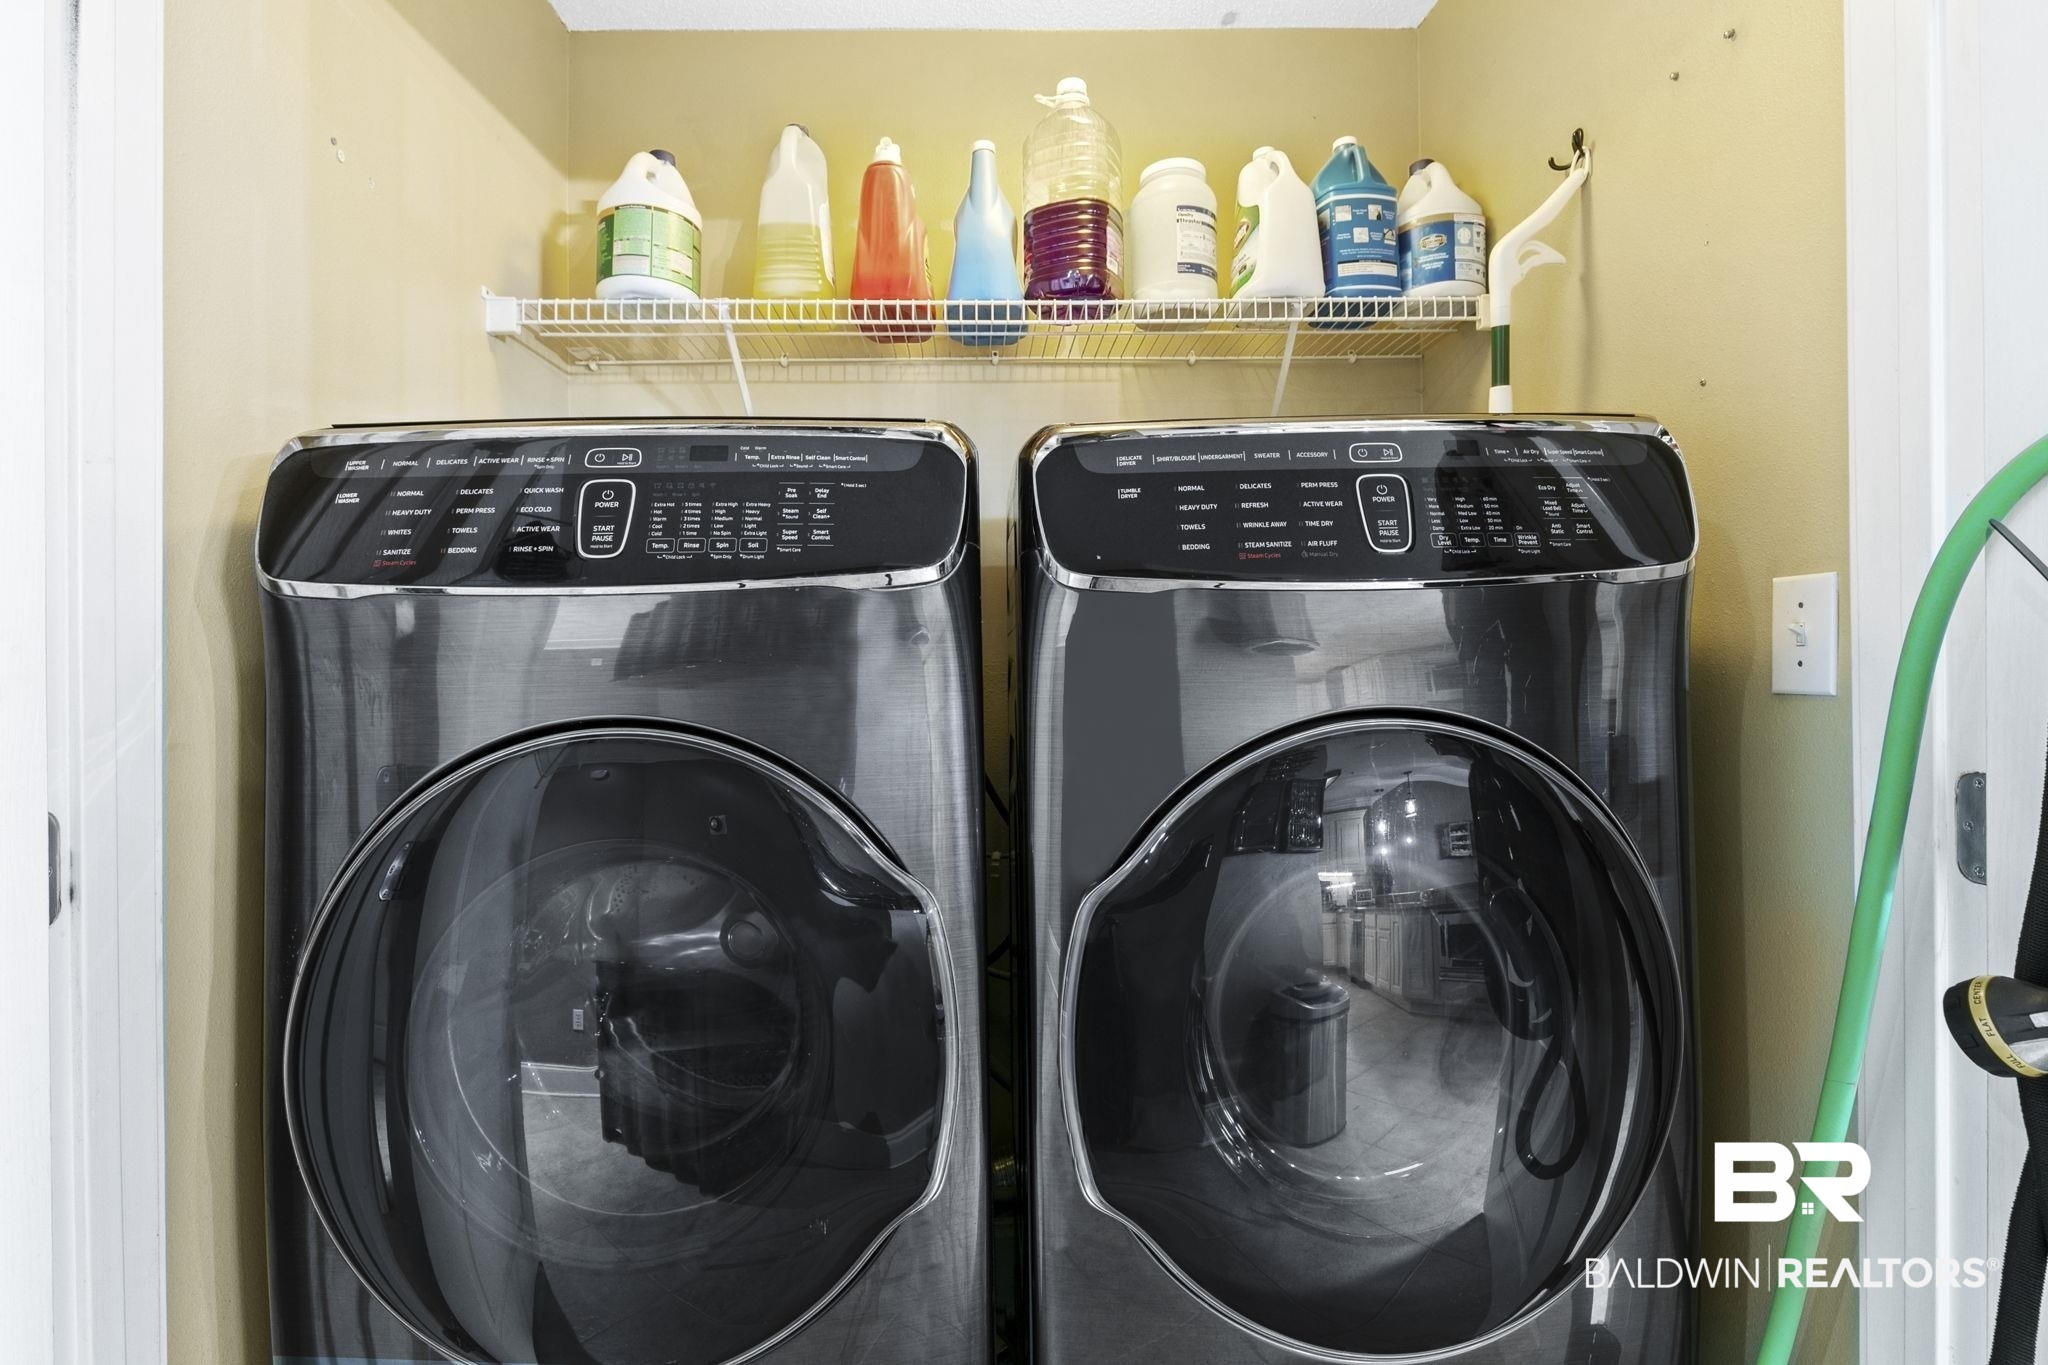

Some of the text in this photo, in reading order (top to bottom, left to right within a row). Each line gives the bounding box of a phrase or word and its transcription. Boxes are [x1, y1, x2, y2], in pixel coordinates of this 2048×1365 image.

[1973, 980, 1984, 1005] CENTER
[1979, 1018, 1995, 1038] FLAT
[2006, 1054, 2026, 1069] FULL
